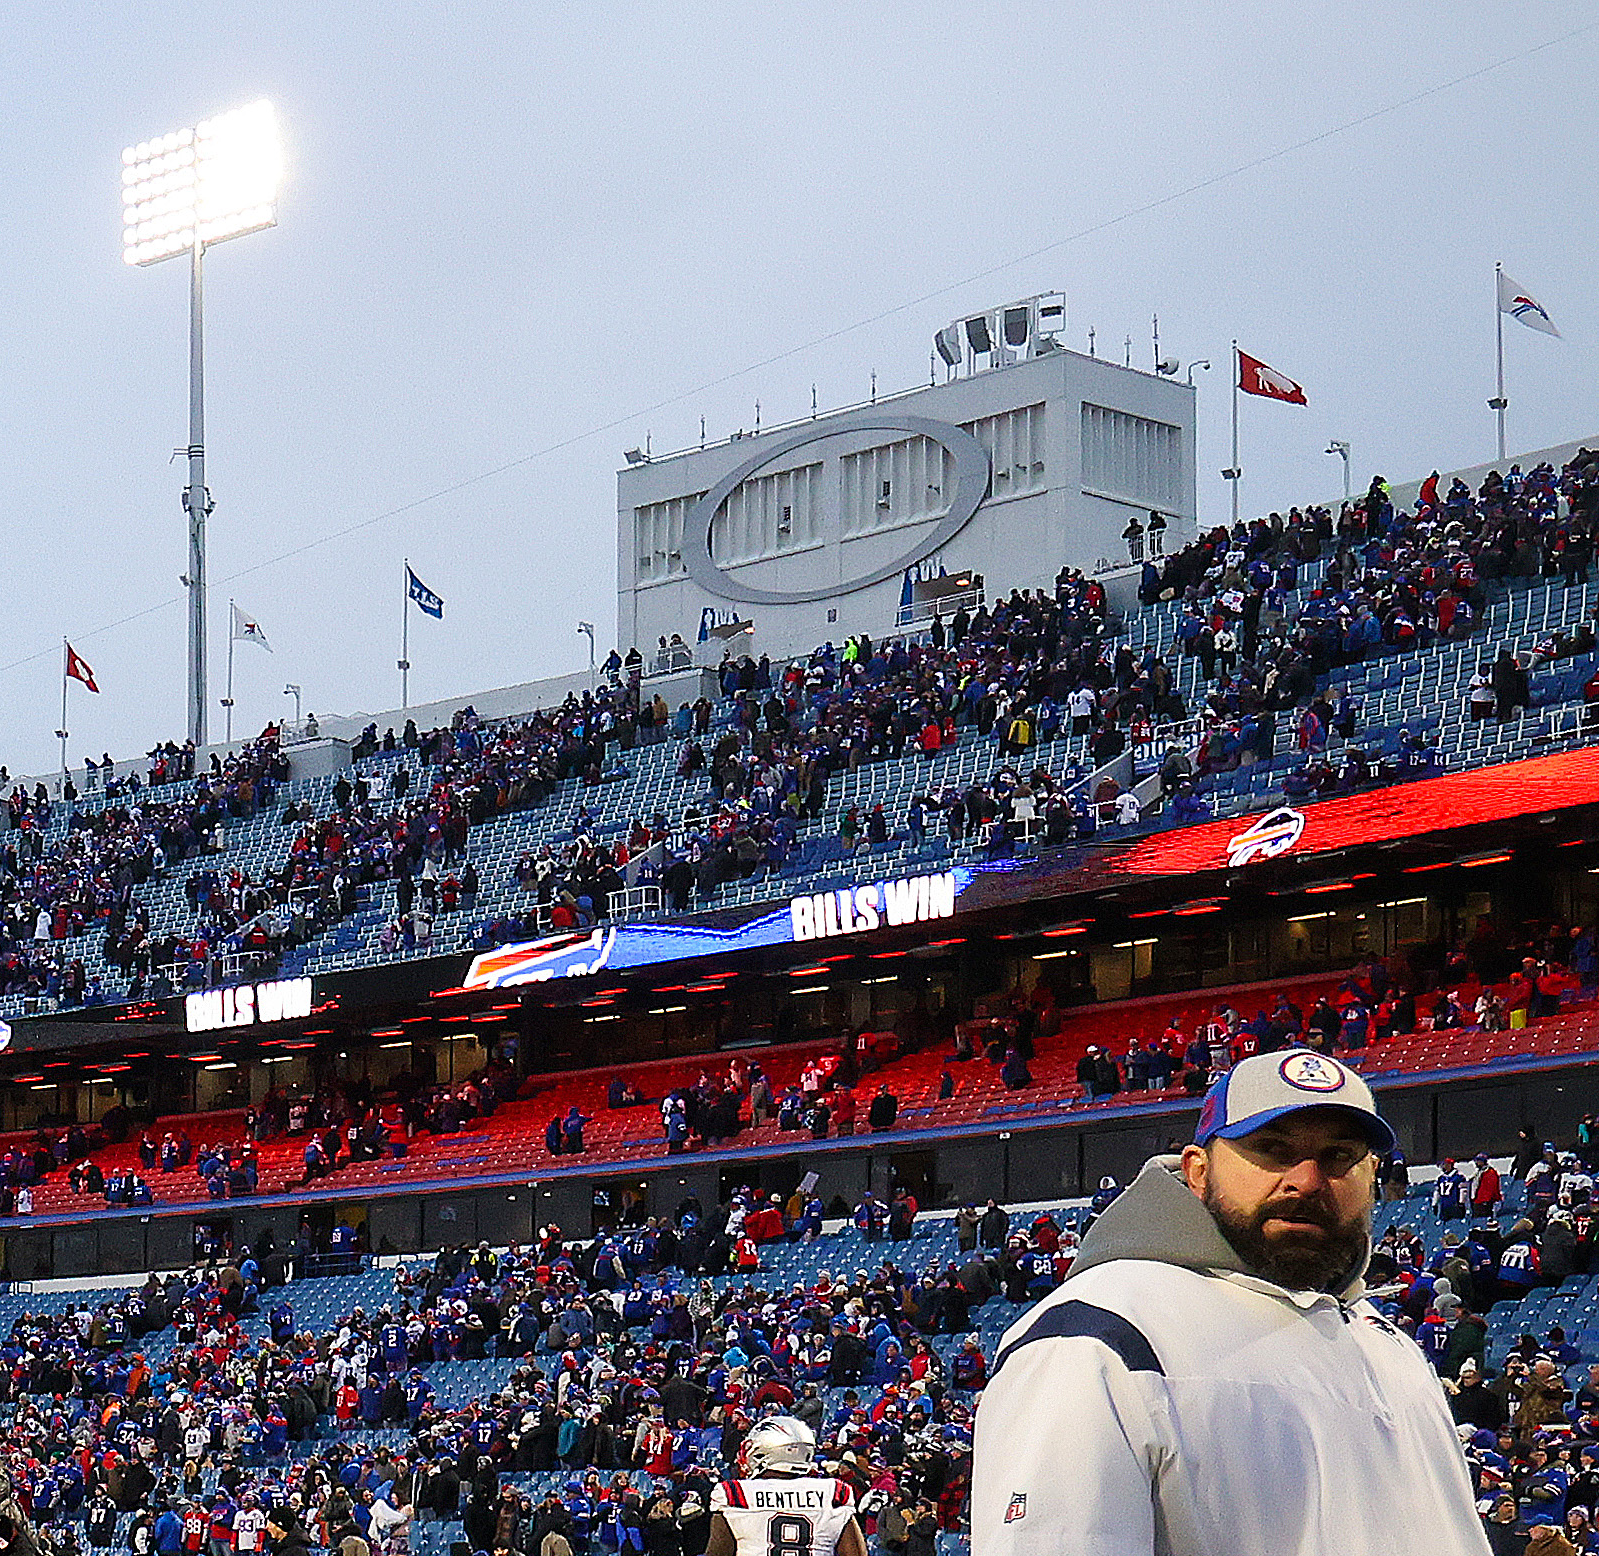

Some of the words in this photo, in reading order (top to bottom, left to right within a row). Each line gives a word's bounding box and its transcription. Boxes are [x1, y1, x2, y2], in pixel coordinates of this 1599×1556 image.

[792, 884, 878, 941] BILLS
[884, 873, 955, 927] WIN
[186, 983, 254, 1032] BILLS
[258, 977, 312, 1024] WIN
[406, 1387, 418, 1400] 17
[118, 1430, 134, 1444] 34
[478, 1429, 490, 1443] 17
[756, 1491, 823, 1508] BENTLEY
